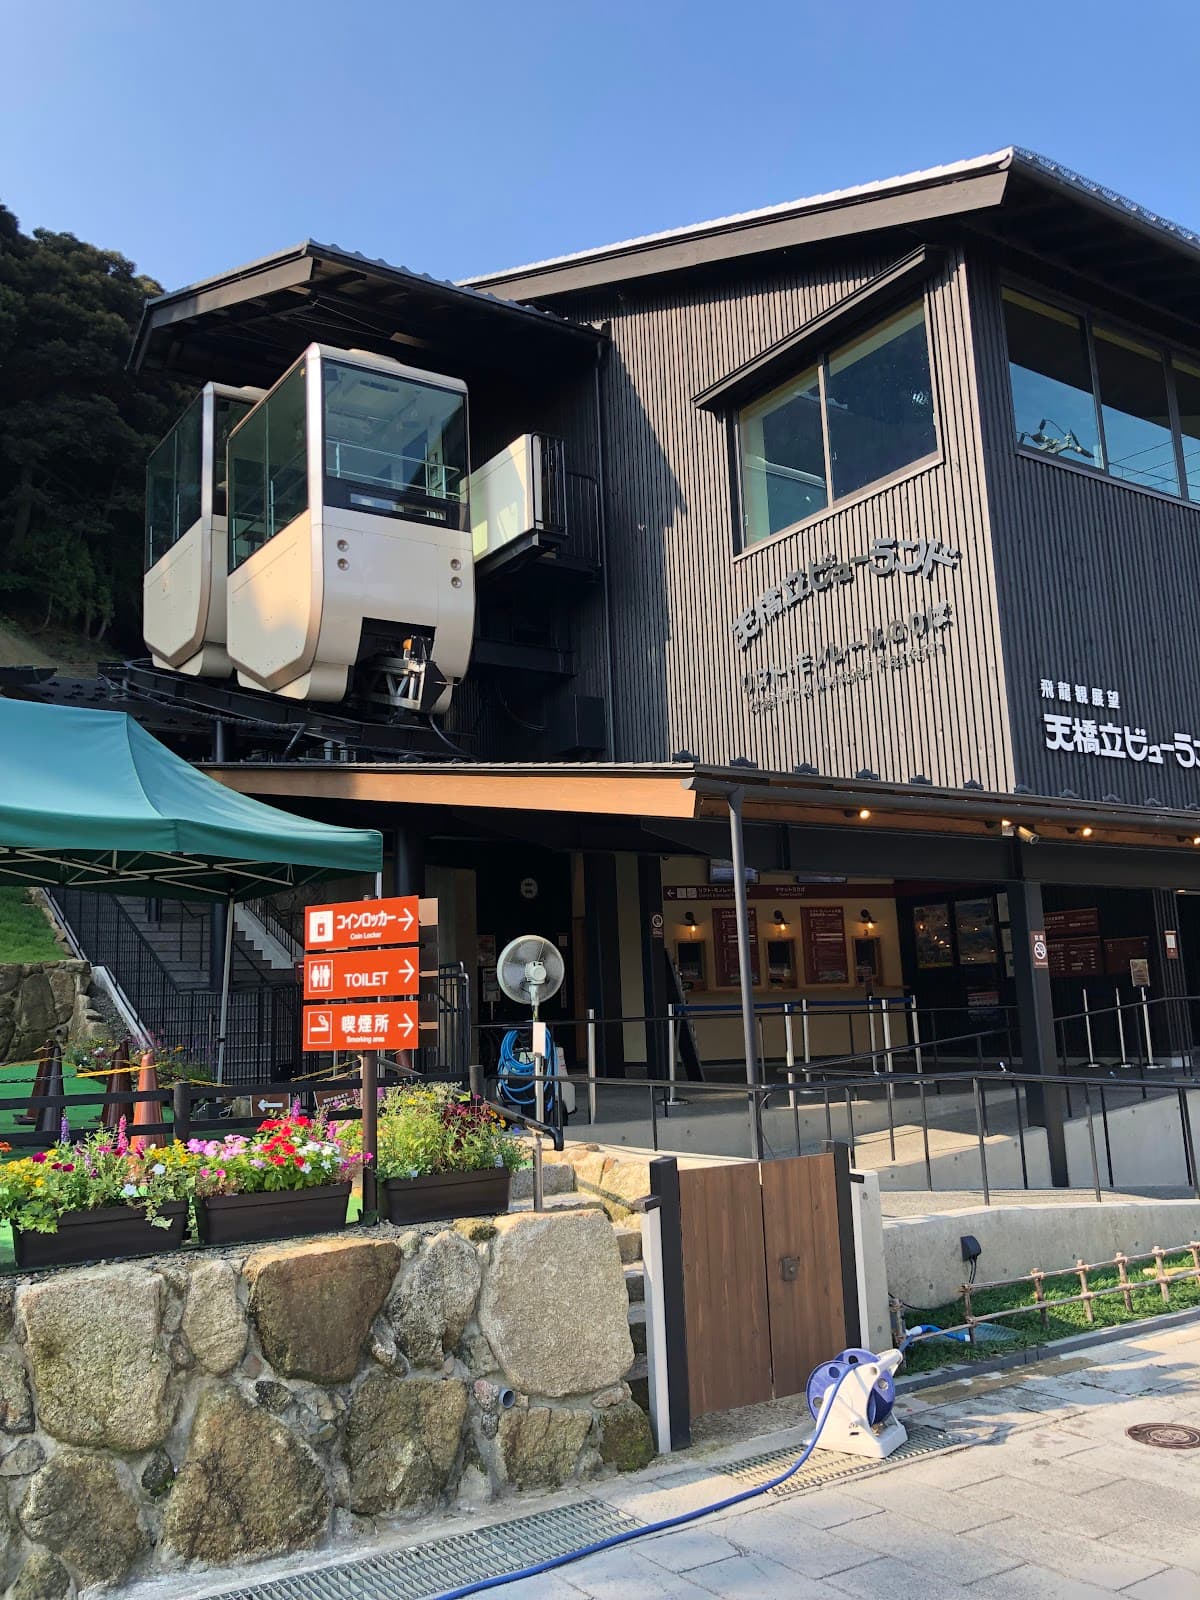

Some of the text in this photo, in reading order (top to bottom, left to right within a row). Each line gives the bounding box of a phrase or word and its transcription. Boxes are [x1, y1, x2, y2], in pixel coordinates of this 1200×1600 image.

[1043, 713, 1200, 768] 天橋立ビューラ
[337, 910, 396, 930] コインロッカー
[350, 931, 382, 941] Coin Locker
[344, 971, 389, 988] TOILET
[341, 1014, 389, 1034] 喫煙所
[346, 1036, 371, 1044] Smoking
